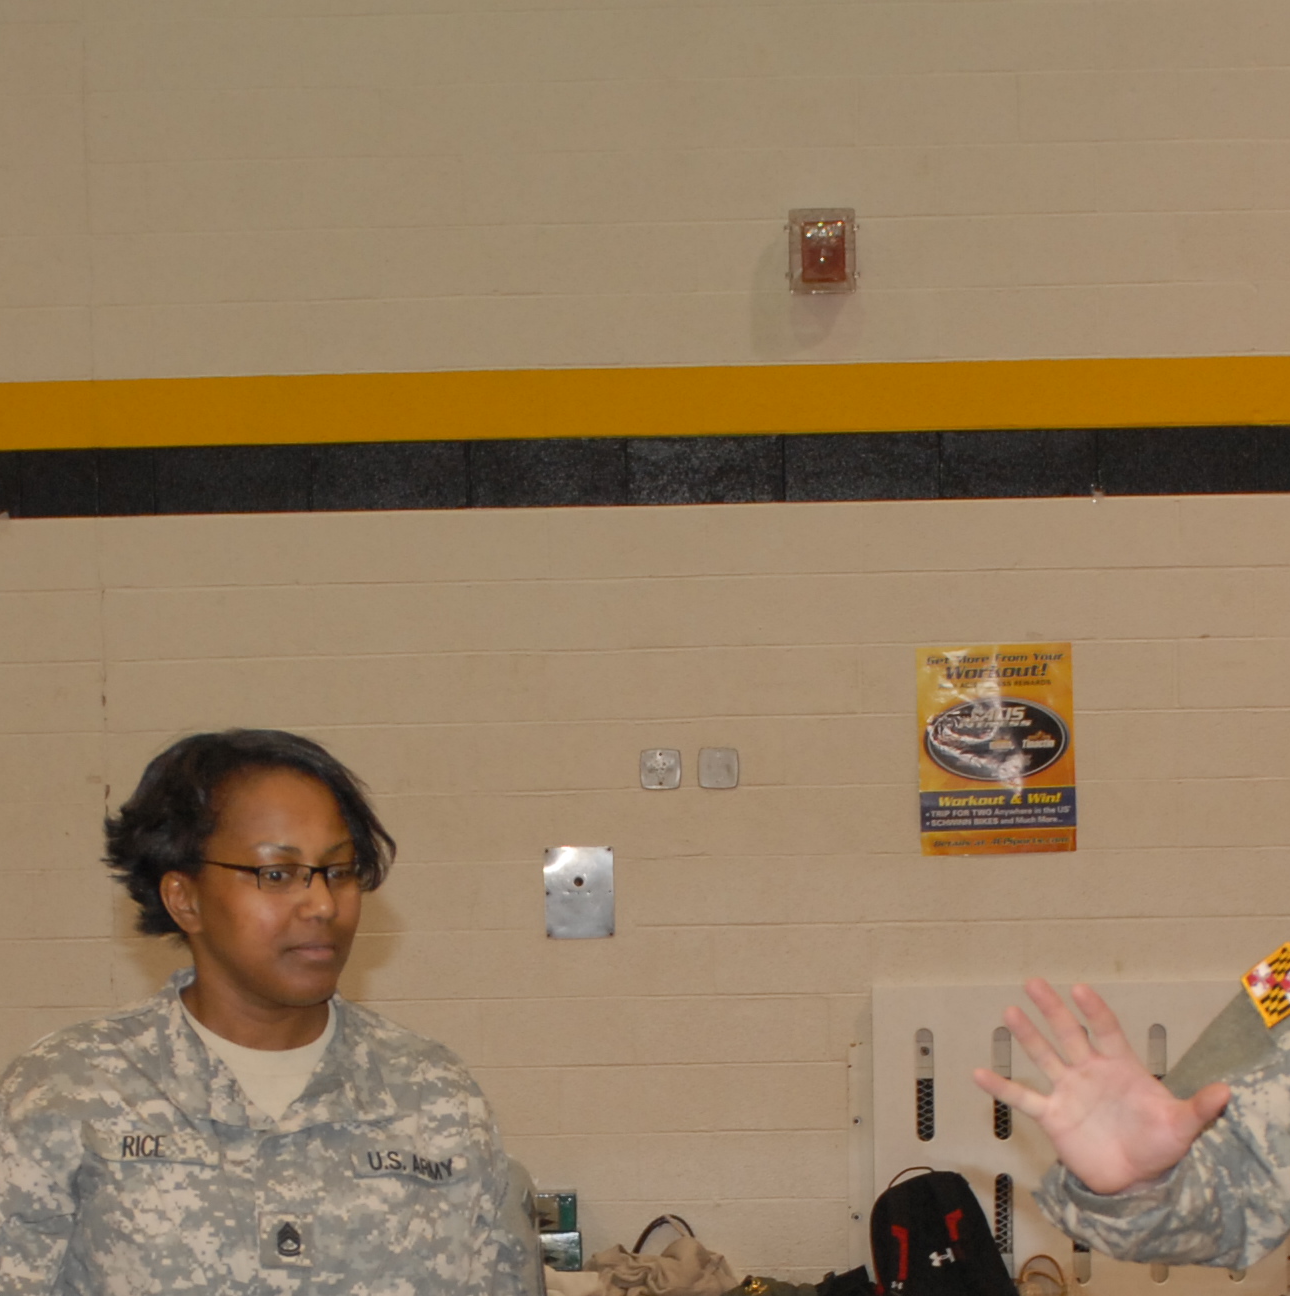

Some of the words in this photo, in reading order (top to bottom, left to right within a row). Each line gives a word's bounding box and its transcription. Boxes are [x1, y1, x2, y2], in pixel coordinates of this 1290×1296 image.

[1033, 653, 1063, 661] Your
[945, 663, 1048, 680] Workout!
[938, 794, 1006, 807] Workout
[1010, 793, 1023, 805] &
[1027, 792, 1062, 804] Win!
[931, 810, 950, 818] TRIP
[952, 809, 969, 817] FOR
[994, 808, 1032, 817] Anywhere
[1043, 806, 1055, 814] the
[973, 817, 999, 825] BIKES
[122, 1134, 167, 1157] RICE
[367, 1150, 407, 1171] U.S.
[412, 1154, 453, 1180] ARMY
